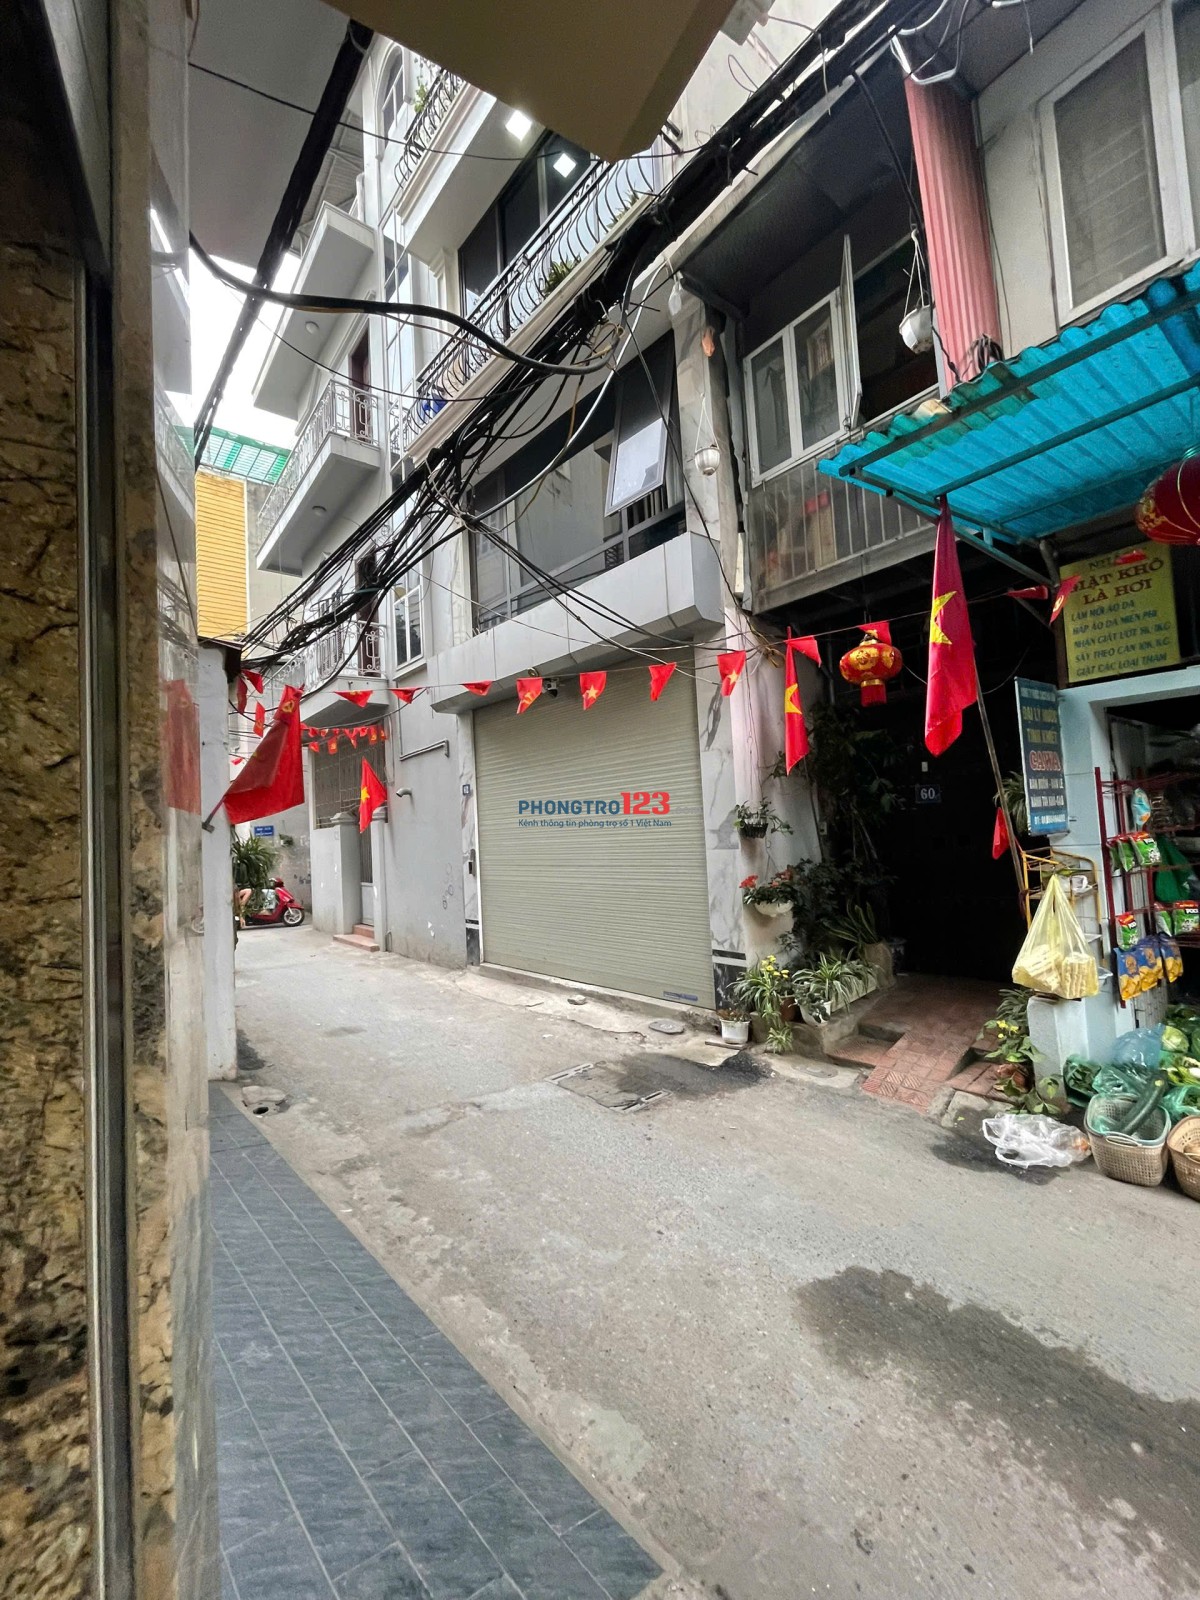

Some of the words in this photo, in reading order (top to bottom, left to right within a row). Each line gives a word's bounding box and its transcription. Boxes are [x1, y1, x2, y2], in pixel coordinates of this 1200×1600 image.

[1118, 557, 1164, 580] KHÔ
[1083, 588, 1108, 605] LÀ
[920, 787, 936, 800] 60
